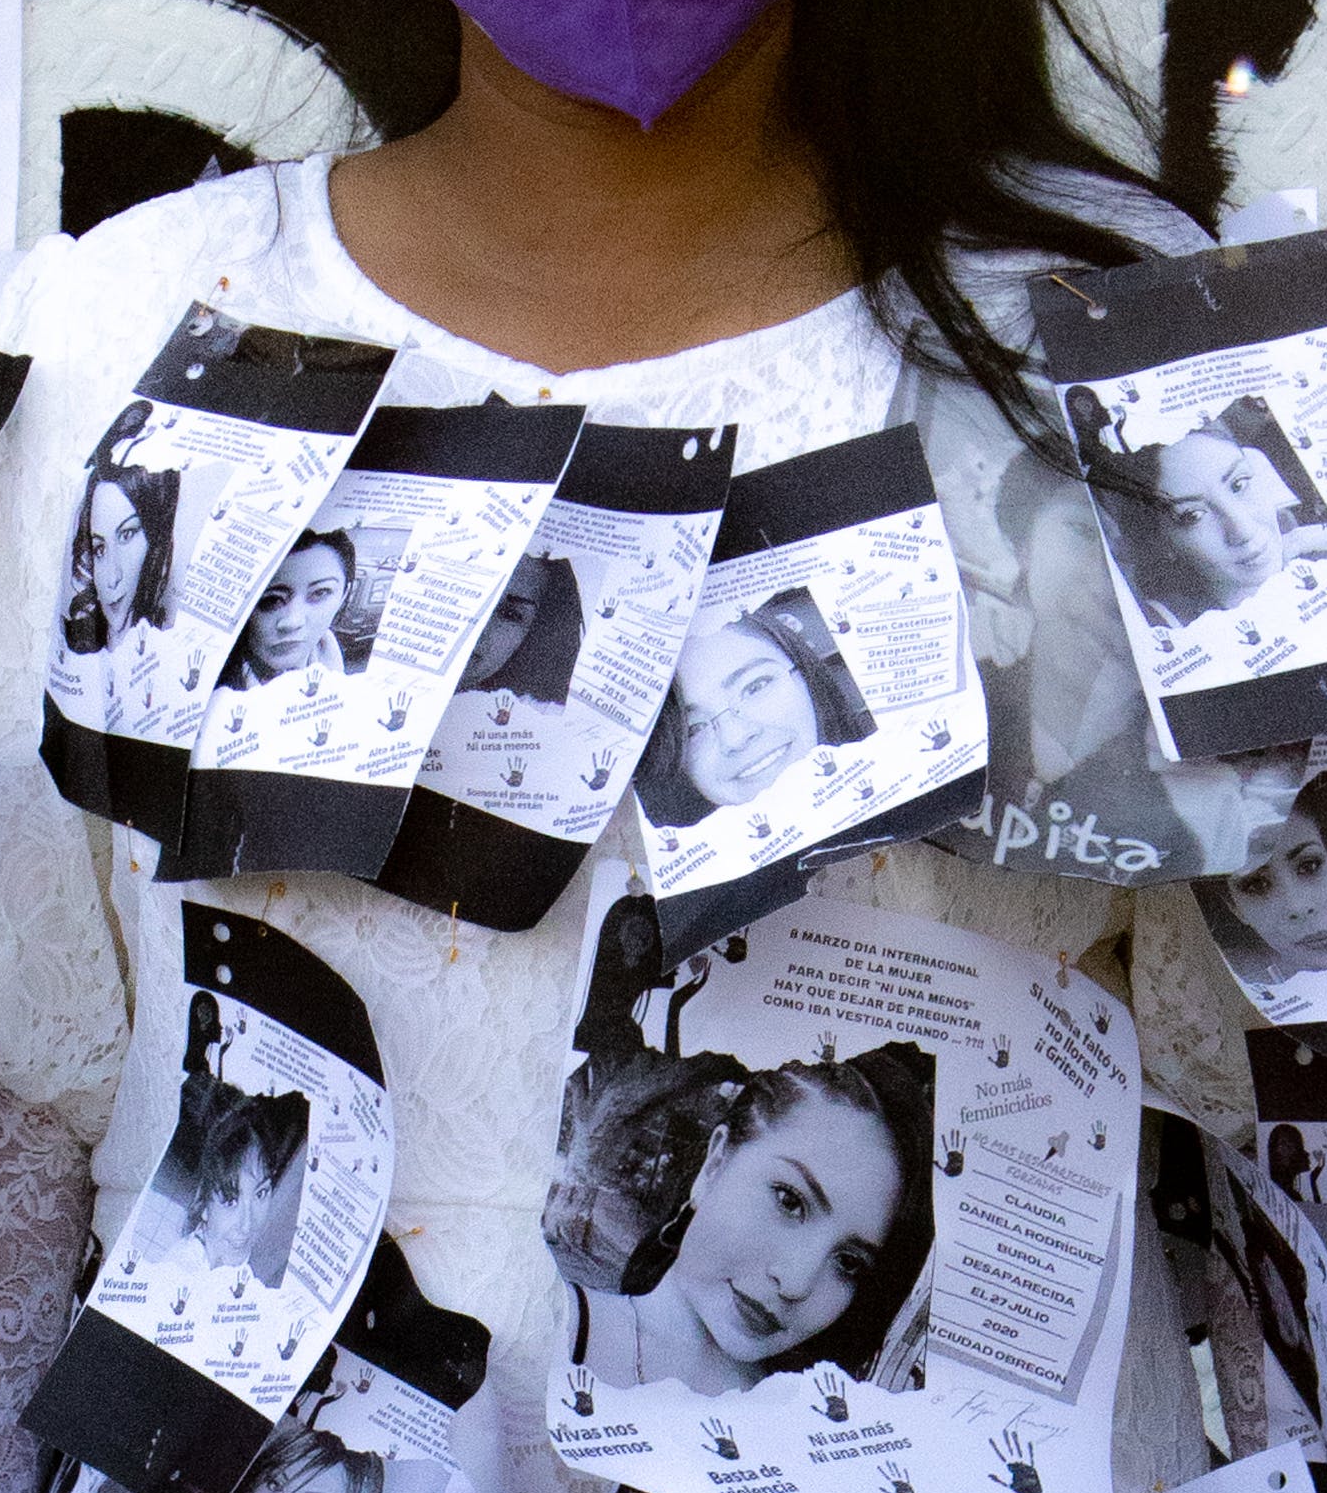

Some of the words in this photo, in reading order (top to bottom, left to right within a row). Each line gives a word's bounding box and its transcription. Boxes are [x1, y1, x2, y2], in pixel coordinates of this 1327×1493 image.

[789, 928, 799, 939] 8
[801, 930, 851, 950] MARZO
[853, 941, 877, 955] DIA
[881, 947, 979, 978] INTERNACIONAL
[787, 963, 824, 980] PARA
[828, 971, 871, 990] DECIR
[874, 980, 895, 994] "NI
[897, 985, 925, 1001] UNA
[927, 992, 975, 1011] MENOS"
[844, 957, 864, 971] DE
[866, 961, 884, 975] LA
[887, 966, 932, 985] MUJER
[773, 978, 804, 993] HAY
[806, 985, 836, 1001] QUE
[838, 991, 885, 1010] DEJAR
[886, 1001, 904, 1015] DE
[907, 1005, 982, 1031] PREGUNTAR
[1044, 1021, 1063, 1043] no
[1062, 1036, 1107, 1080] lloren
[974, 1081, 999, 1100] No
[1000, 1073, 1035, 1098] más
[959, 1092, 1053, 1125] feminicidios
[1004, 1193, 1067, 1227] CLAUDIA
[958, 1201, 1023, 1235] DANIELA
[1024, 1228, 1105, 1267] RODRÍGUEZ
[961, 1255, 1075, 1308] DESAPARECIDA
[970, 1286, 989, 1303] EL
[989, 1293, 1009, 1307] 27
[1007, 1303, 1050, 1324] JULIO
[981, 1318, 1019, 1339] 2020
[550, 1422, 603, 1444] Vivas
[602, 1423, 639, 1438] nos
[807, 1431, 829, 1447] Ni
[828, 1429, 860, 1444] una
[859, 1420, 895, 1439] más
[563, 1441, 654, 1462] queremos
[807, 1449, 830, 1464] Ni
[828, 1447, 861, 1461] una
[860, 1437, 913, 1456] menos
[706, 1469, 760, 1486] Basta
[758, 1463, 784, 1479] de
